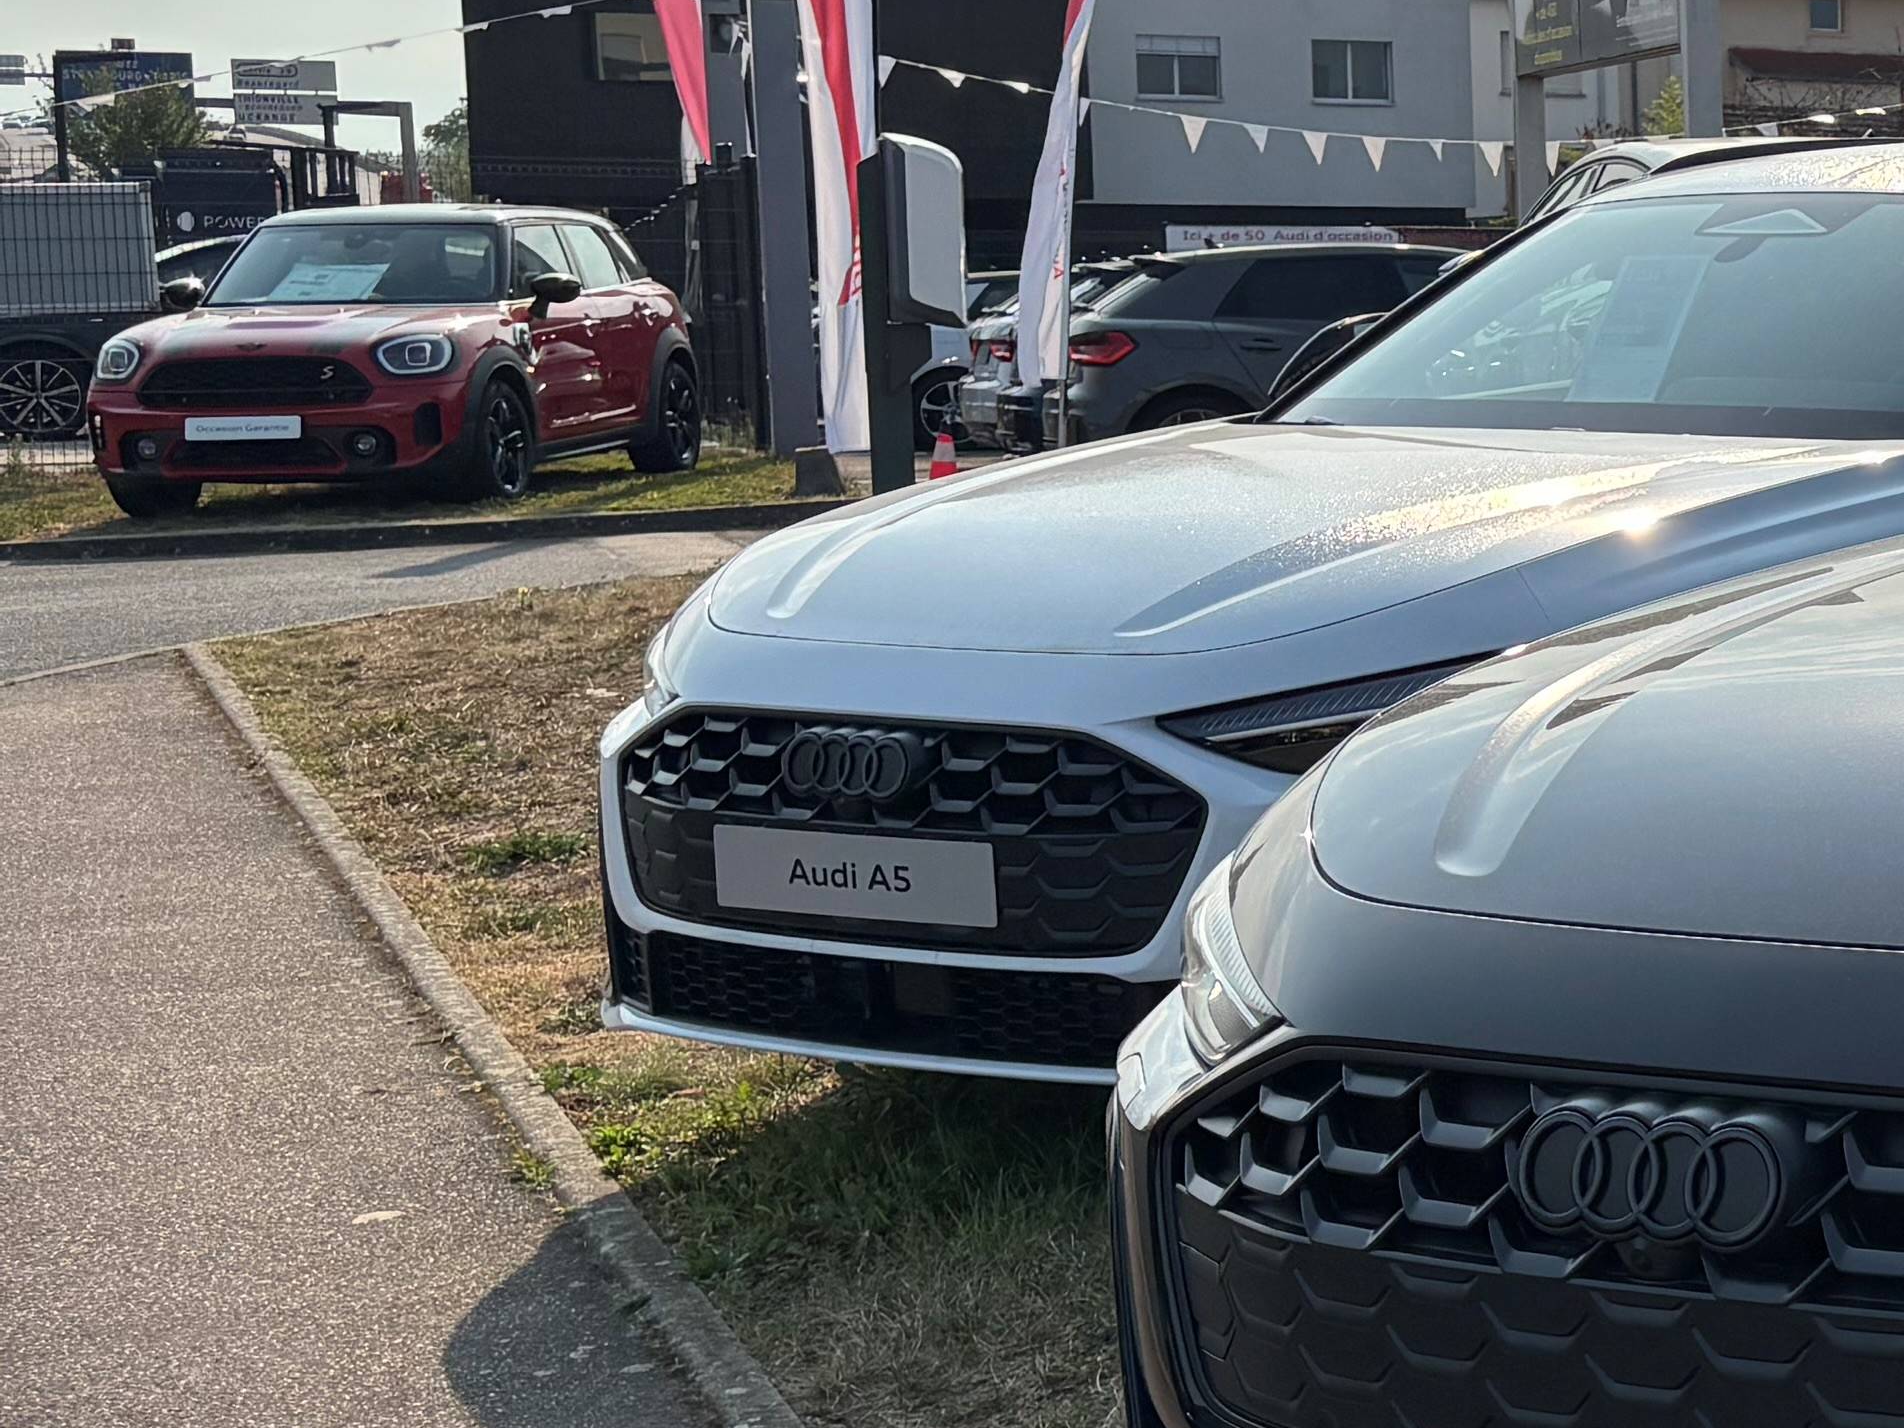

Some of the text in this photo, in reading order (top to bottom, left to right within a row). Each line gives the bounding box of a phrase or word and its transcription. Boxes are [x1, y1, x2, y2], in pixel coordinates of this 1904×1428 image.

[1183, 229, 1201, 241] Ici
[1221, 229, 1240, 241] de
[1244, 229, 1266, 241] 50
[1273, 229, 1309, 241] Audi
[1313, 229, 1393, 241] d'occasion
[320, 365, 335, 380] S
[788, 858, 912, 893] Audi A5
